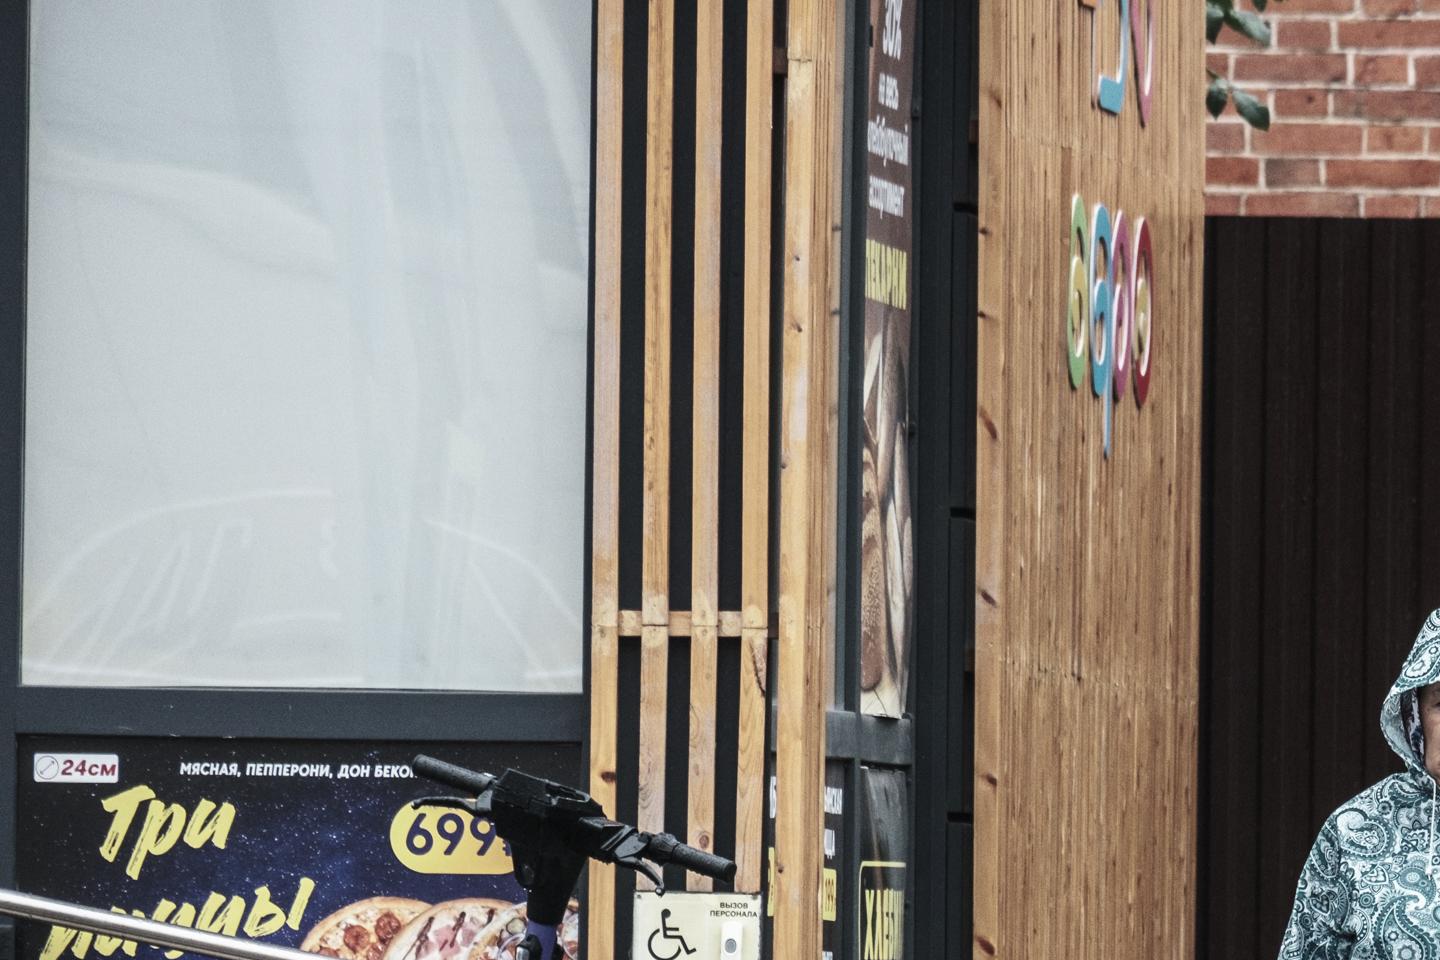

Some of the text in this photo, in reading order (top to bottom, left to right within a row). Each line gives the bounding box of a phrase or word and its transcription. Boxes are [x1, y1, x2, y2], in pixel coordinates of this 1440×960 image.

[179, 762, 242, 778] МЯСНАЯ,
[245, 763, 334, 780] ПЕППЕРОНИ,
[337, 764, 370, 779] ДОН
[99, 784, 237, 880] Три
[719, 902, 749, 910] ВЫЗОВ
[709, 909, 758, 918] ПЕРСОНАЛА
